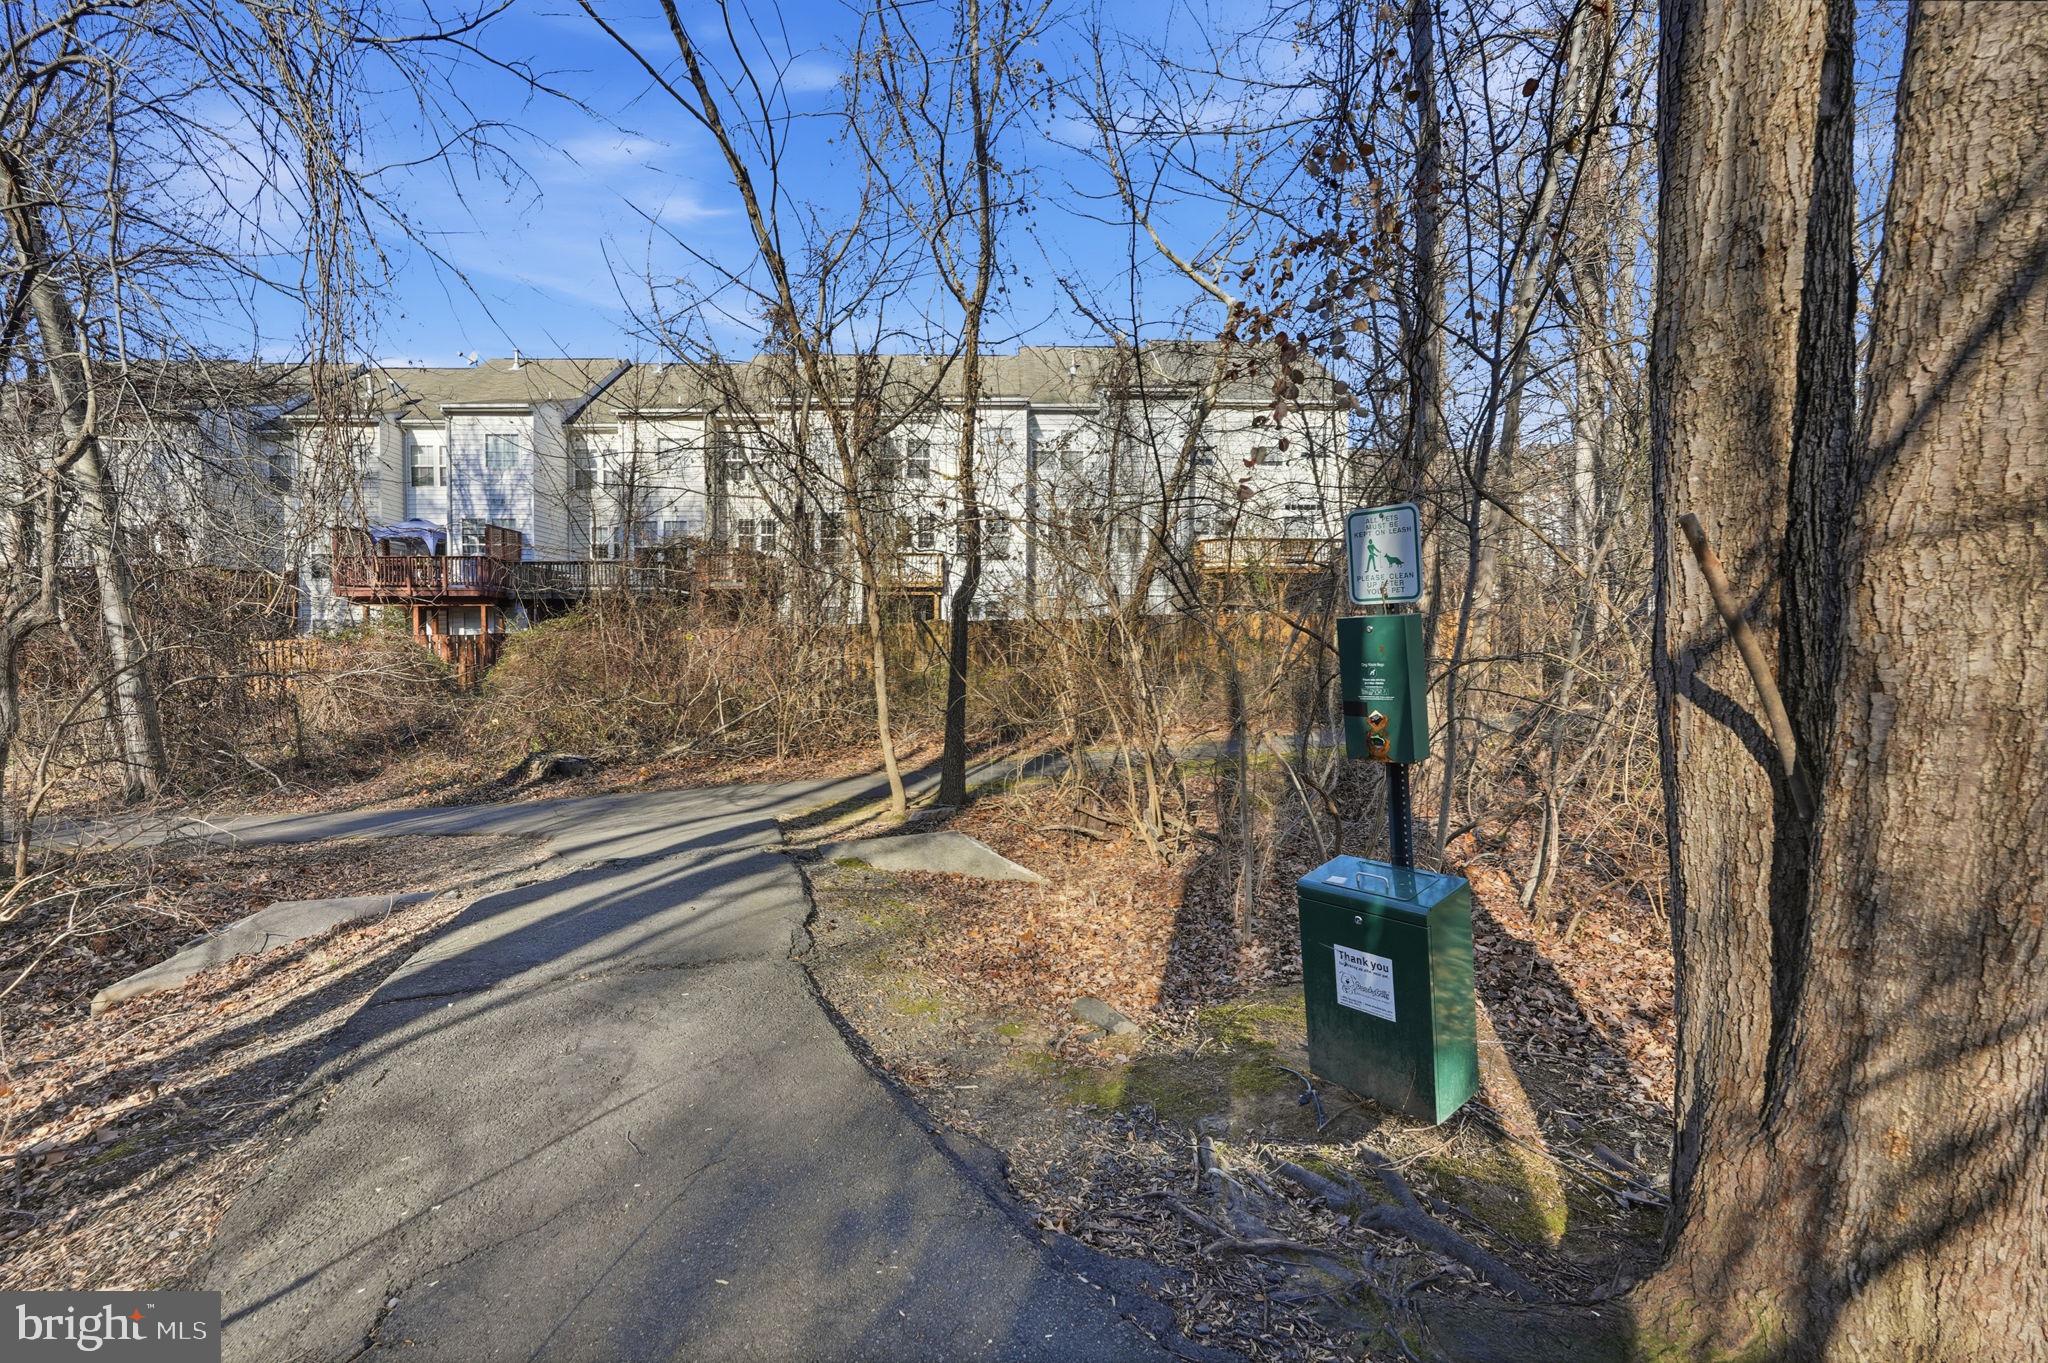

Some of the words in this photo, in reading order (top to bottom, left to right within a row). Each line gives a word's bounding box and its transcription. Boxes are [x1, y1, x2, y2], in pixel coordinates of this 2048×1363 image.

[1365, 522, 1386, 530] MUST
[1354, 530, 1372, 538] KEPT
[1389, 526, 1412, 535] LEASH
[1356, 573, 1385, 582] PLEASE
[1389, 572, 1414, 580] CLEAN
[1339, 950, 1369, 967] Thank
[1370, 961, 1389, 973] you
